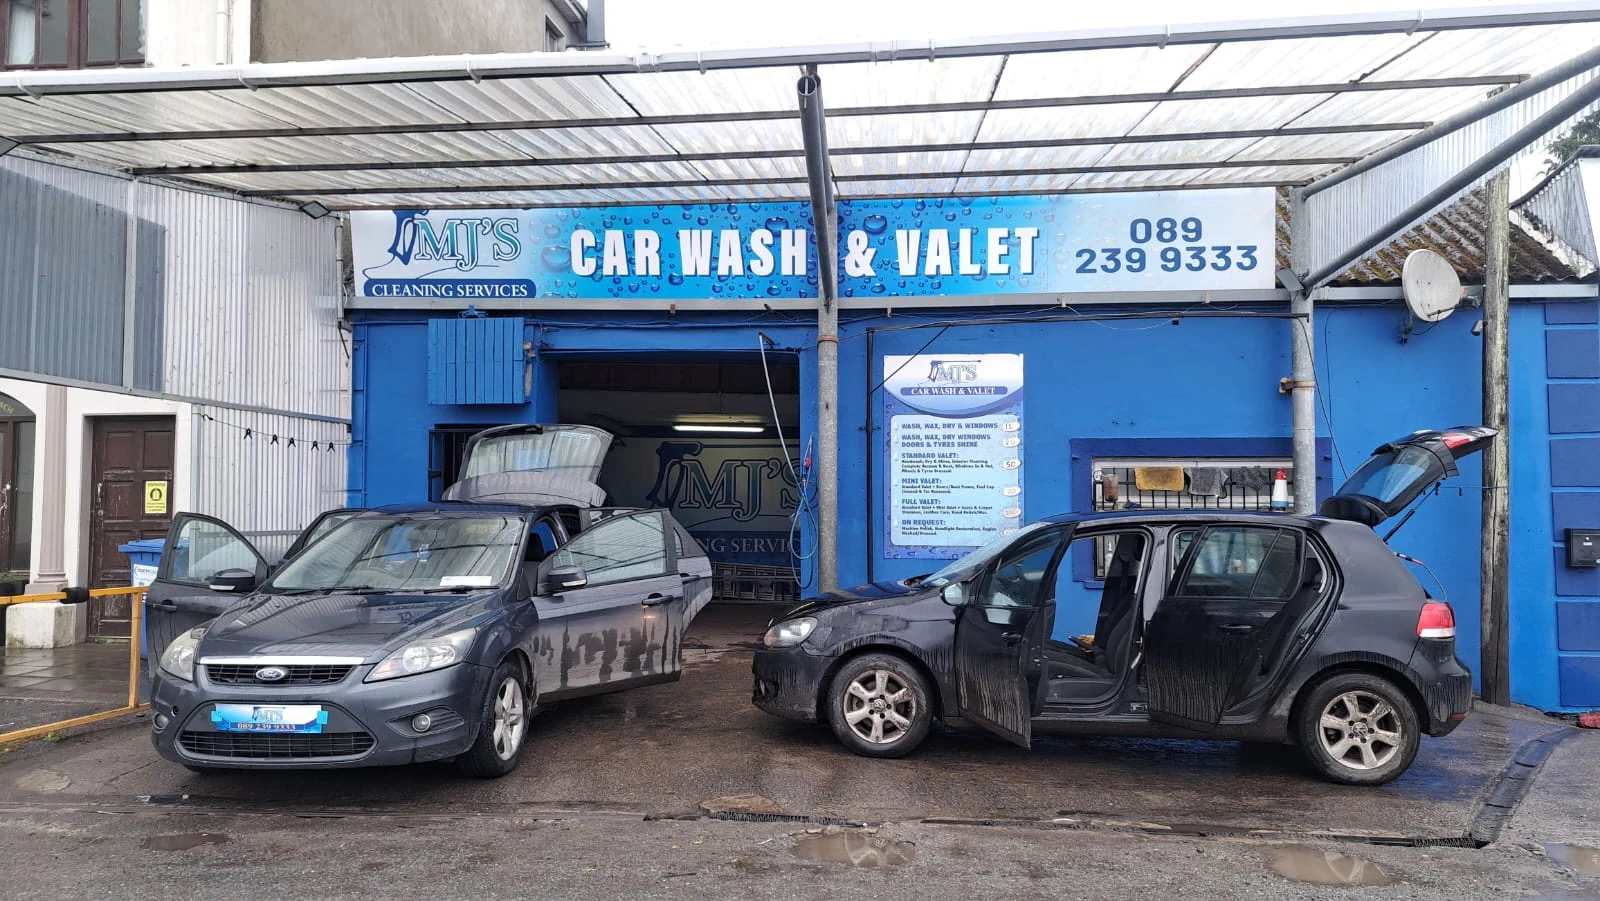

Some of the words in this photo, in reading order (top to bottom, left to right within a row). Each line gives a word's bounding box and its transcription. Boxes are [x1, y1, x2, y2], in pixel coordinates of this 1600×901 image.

[414, 217, 521, 271] MJ'S
[1129, 217, 1203, 244] 089
[570, 229, 661, 277] CAR
[679, 229, 807, 277] WASH
[844, 242, 877, 278] &
[895, 227, 1039, 276] VALET
[1075, 248, 1147, 274] 239
[1160, 244, 1258, 272] 9333
[371, 283, 454, 297] CLEANING
[457, 284, 528, 298] SERVICES
[911, 387, 931, 395] CAR
[932, 387, 958, 395] WASH
[958, 387, 966, 395] &
[967, 386, 996, 395] VALET
